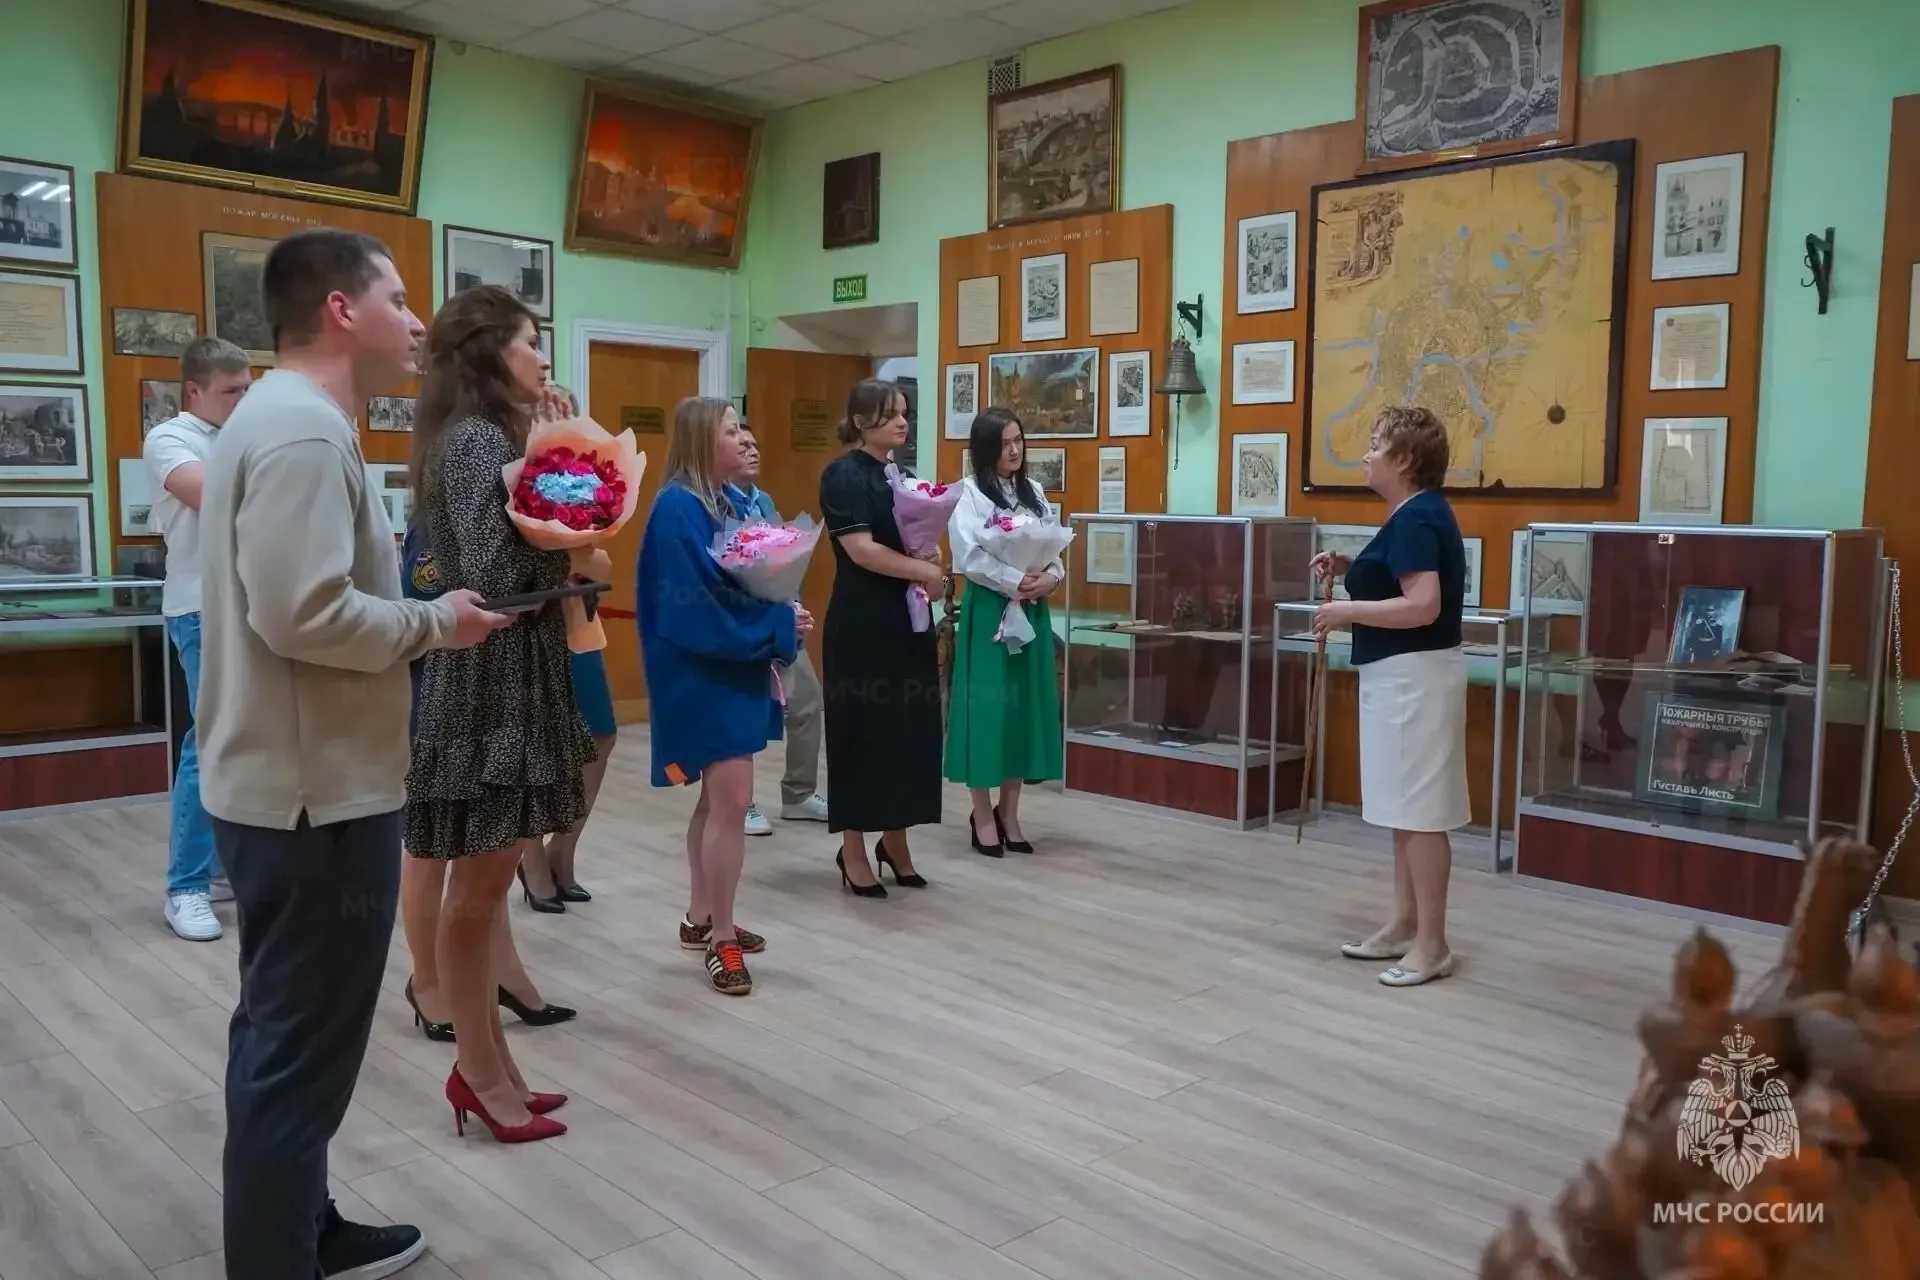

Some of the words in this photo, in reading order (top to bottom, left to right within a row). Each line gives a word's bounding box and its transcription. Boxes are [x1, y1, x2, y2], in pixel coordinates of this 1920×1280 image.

[836, 279, 863, 298] ВЫХОД
[1659, 706, 1725, 724] ПОЖАРНЫЯ
[1727, 713, 1768, 728] ТРУБЫ
